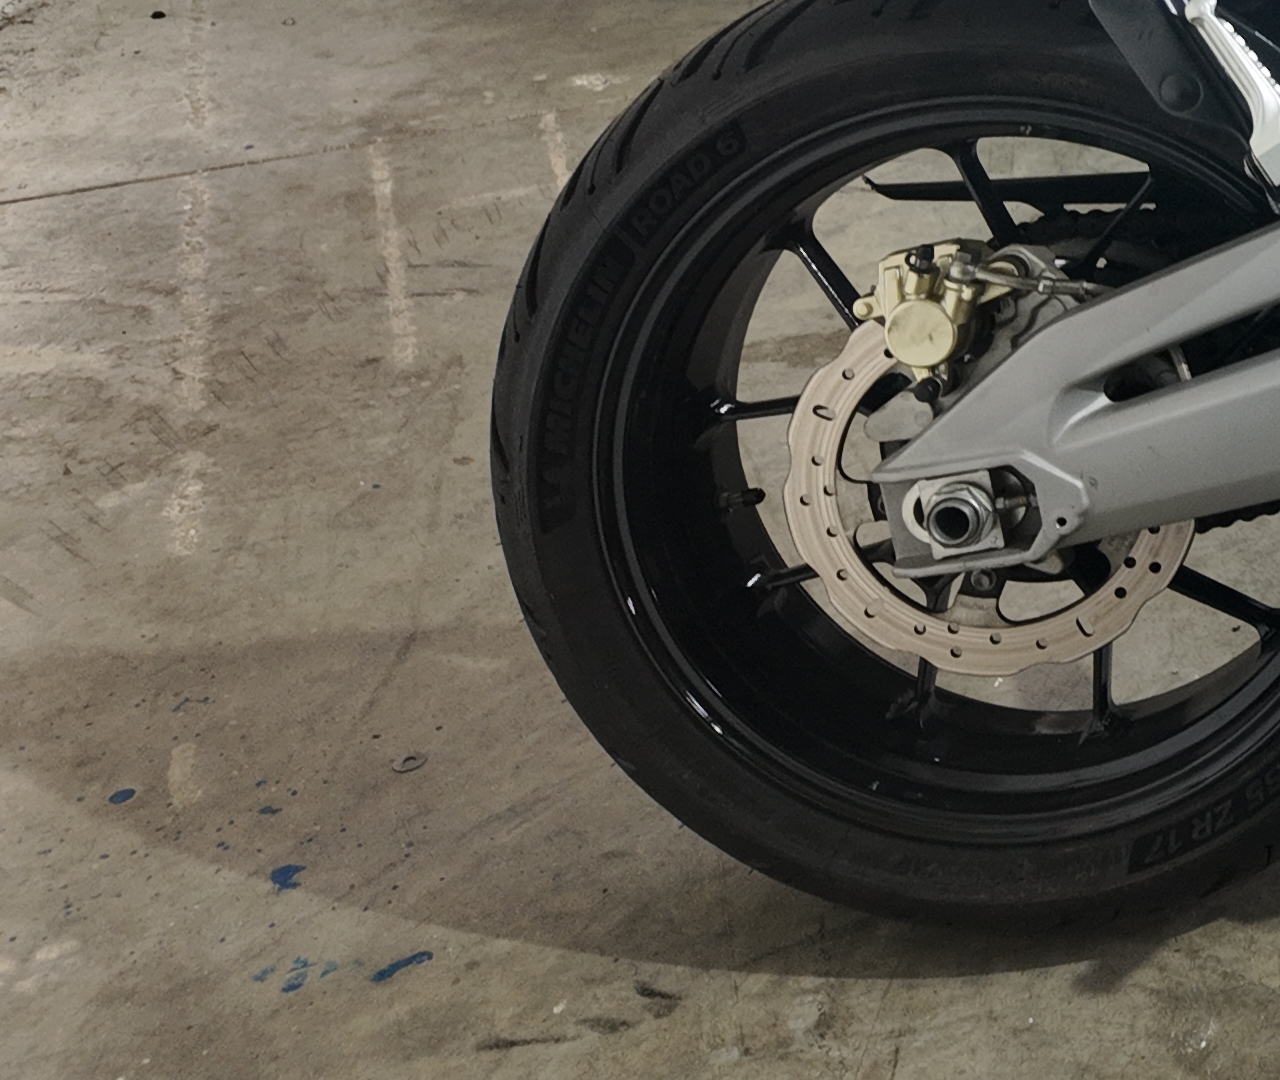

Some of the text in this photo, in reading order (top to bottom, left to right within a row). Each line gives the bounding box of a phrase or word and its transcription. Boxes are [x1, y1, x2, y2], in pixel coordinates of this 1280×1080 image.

[633, 154, 711, 238] ROAD
[716, 129, 741, 155] 6
[1191, 800, 1235, 844] ZR
